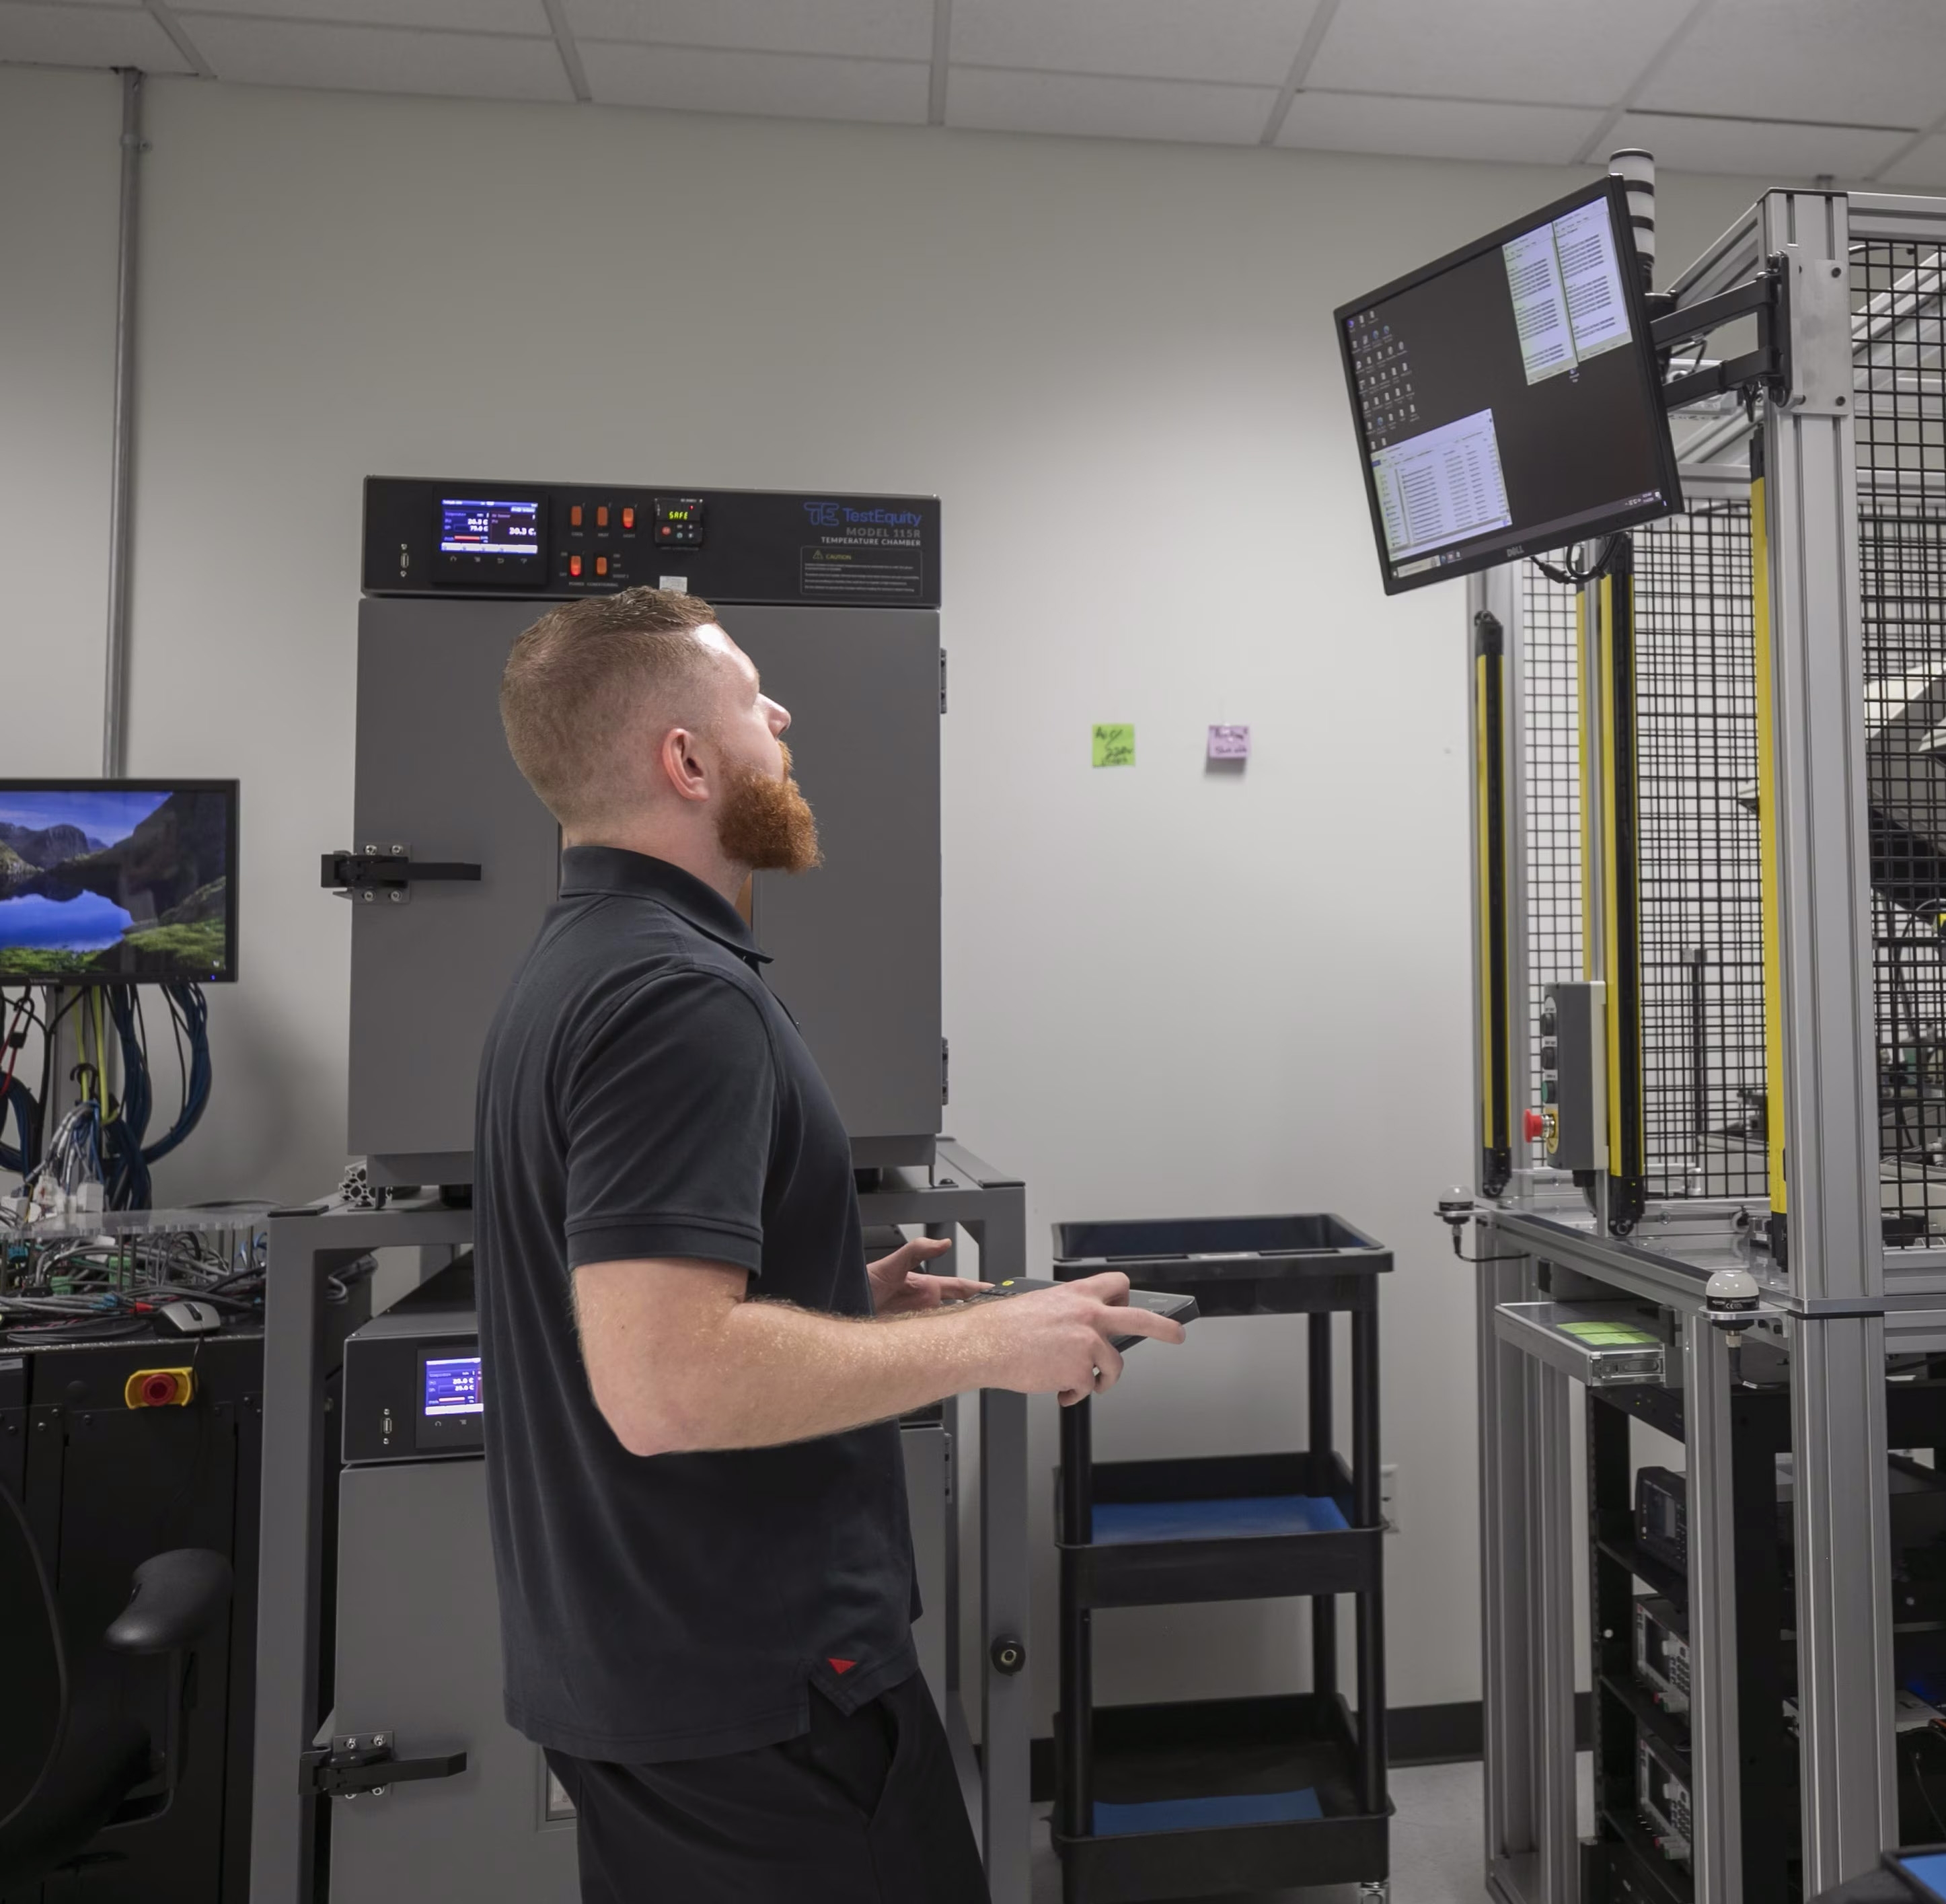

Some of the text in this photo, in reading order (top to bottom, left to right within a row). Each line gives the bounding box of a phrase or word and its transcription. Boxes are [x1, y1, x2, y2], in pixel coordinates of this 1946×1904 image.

[669, 511, 688, 520] SAFE
[842, 507, 922, 527] TestEquity
[846, 527, 921, 538] MODEL 115R
[821, 536, 921, 546] TEMPERATURE CHAMBER
